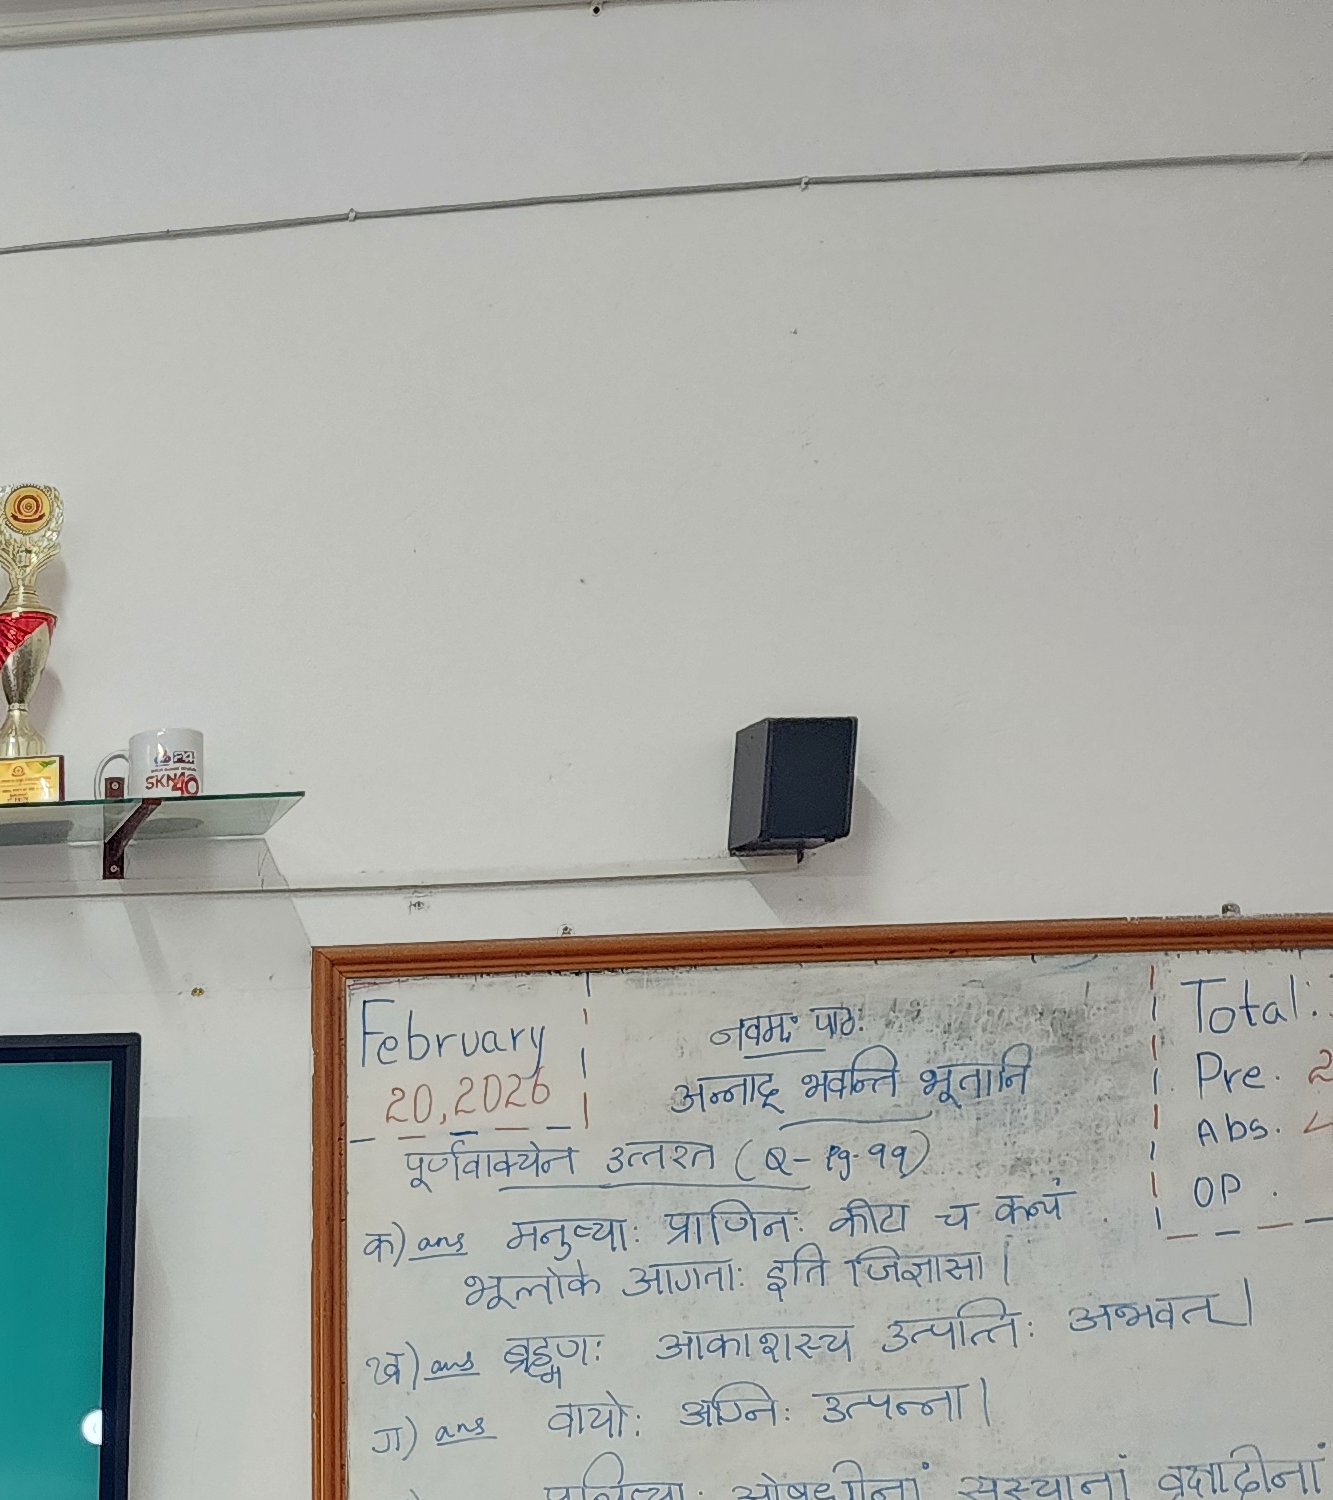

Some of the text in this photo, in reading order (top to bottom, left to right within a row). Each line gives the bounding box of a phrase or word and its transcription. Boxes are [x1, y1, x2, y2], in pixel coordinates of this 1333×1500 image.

[174, 752, 193, 763] 24
[361, 998, 546, 1079] February
[417, 1232, 468, 1255] ans
[935, 1202, 980, 1231] च
[430, 1351, 475, 1376] ans
[435, 1417, 485, 1442] ans
